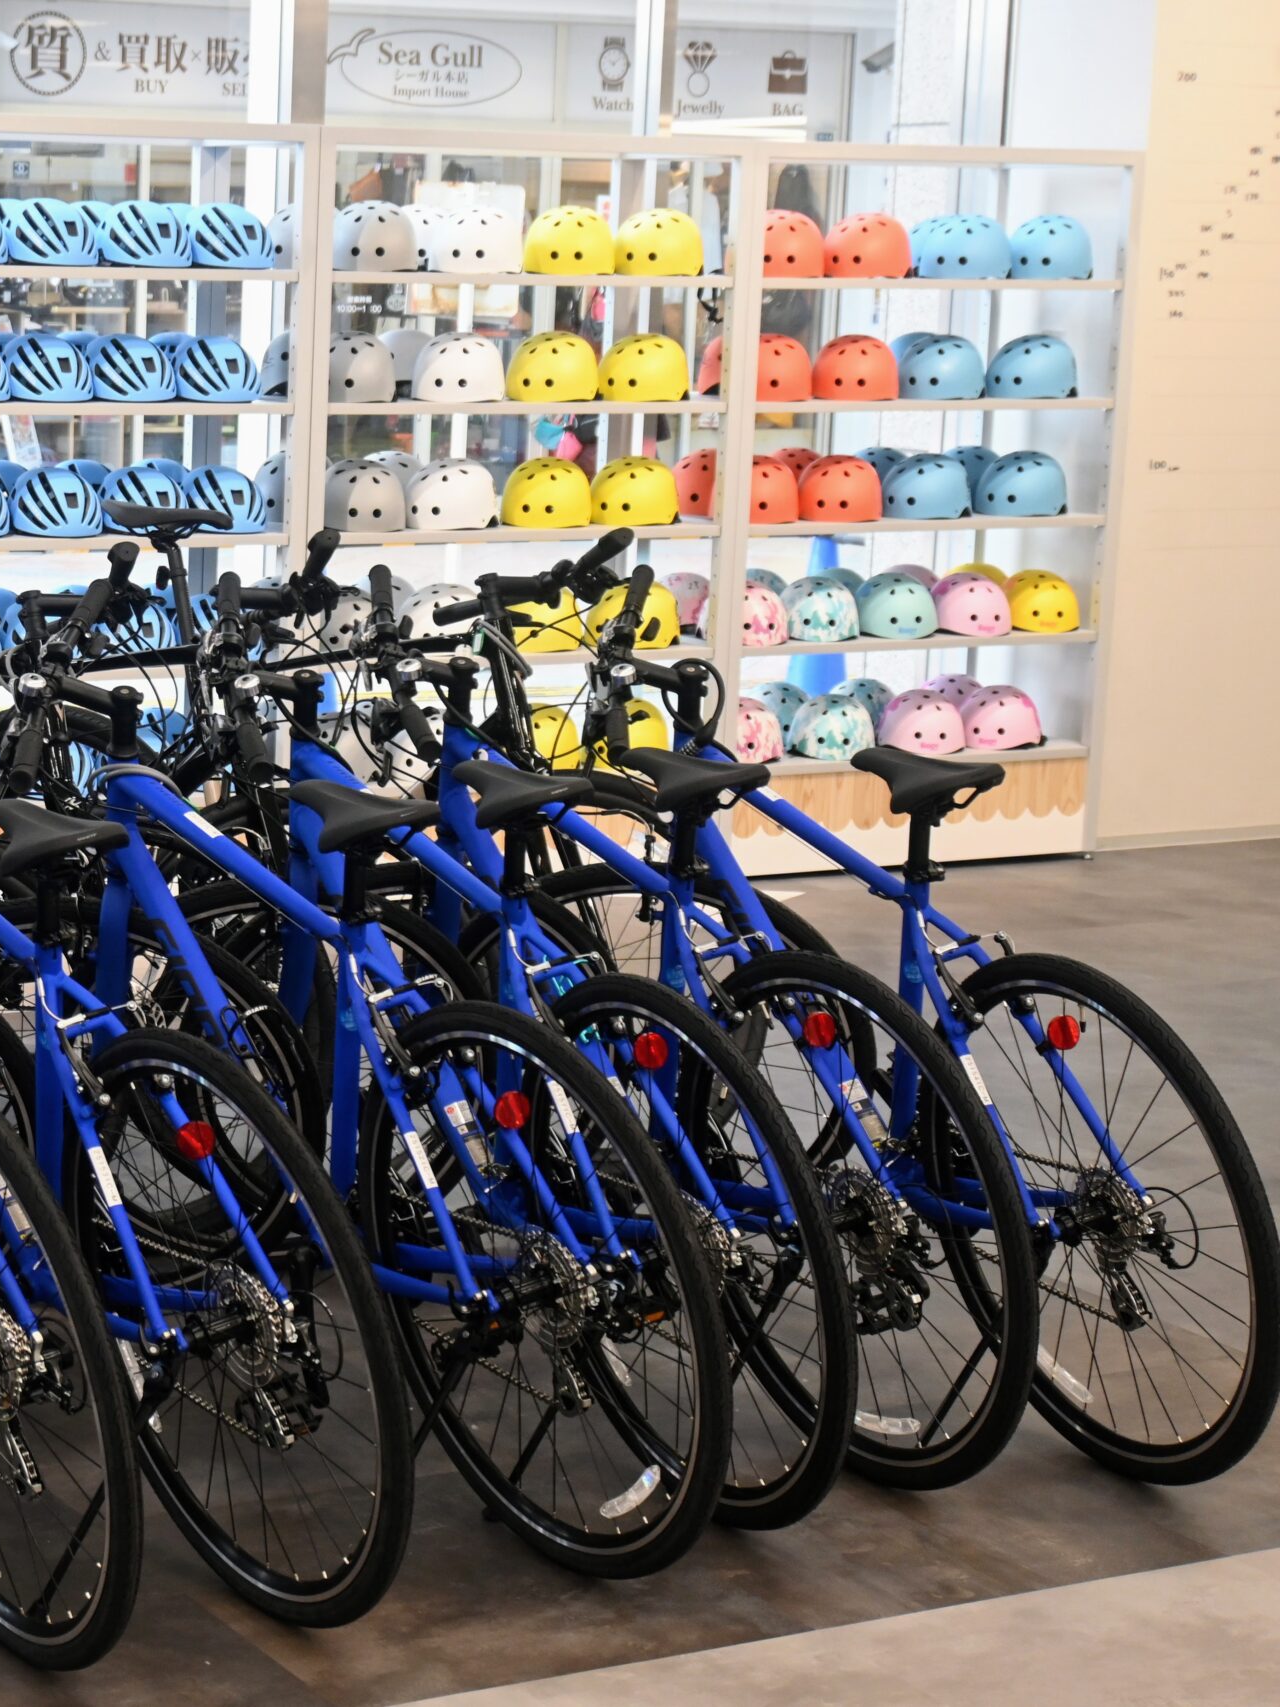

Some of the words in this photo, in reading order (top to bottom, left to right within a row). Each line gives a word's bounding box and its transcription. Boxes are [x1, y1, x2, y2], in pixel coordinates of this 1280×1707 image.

[24, 24, 73, 81] 質
[94, 40, 112, 61] &
[378, 41, 420, 66] Sea
[431, 44, 483, 68] Gull
[135, 79, 168, 93] BUY
[393, 85, 431, 99] Import
[434, 86, 470, 98] House
[593, 97, 634, 112] Watch
[674, 101, 724, 118] Jewelly
[772, 103, 802, 116] BAG
[245, 1005, 268, 1015] GIANT
